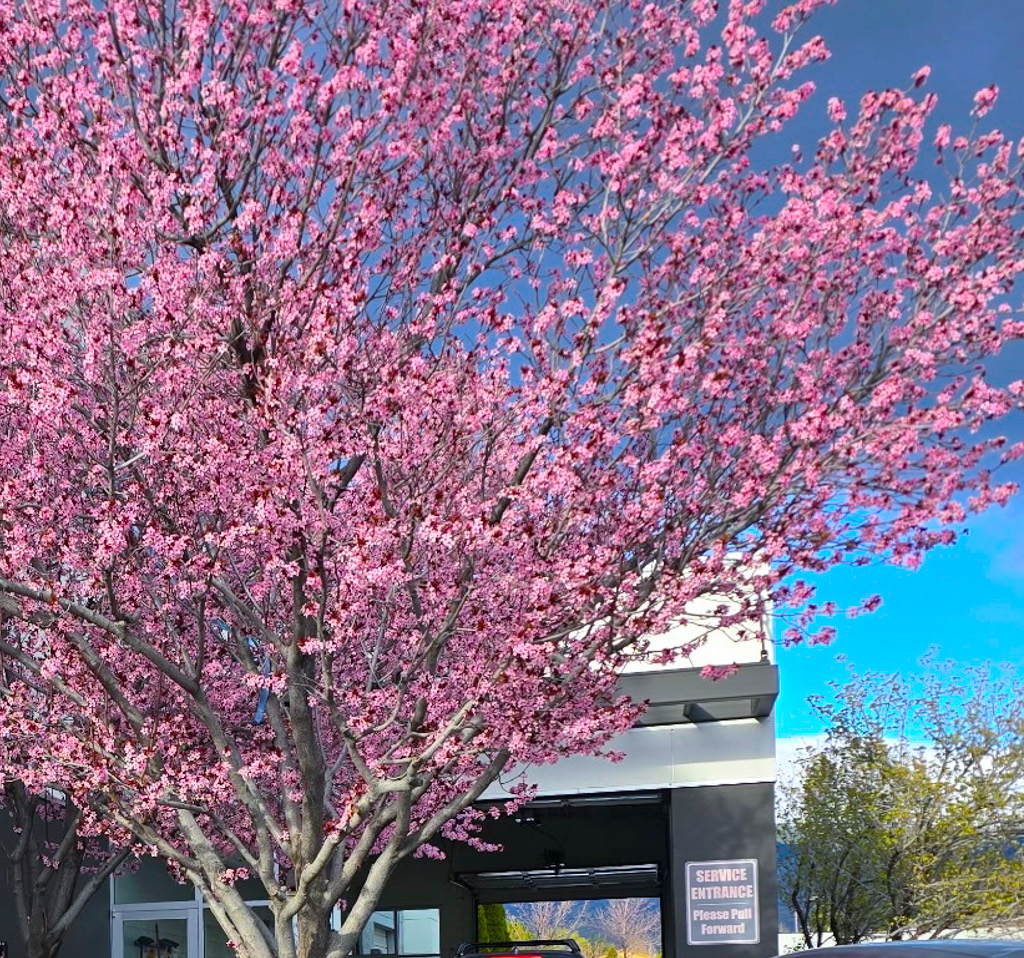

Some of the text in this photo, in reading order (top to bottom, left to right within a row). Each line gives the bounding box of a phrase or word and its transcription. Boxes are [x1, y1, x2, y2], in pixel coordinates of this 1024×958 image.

[696, 868, 748, 882] SERVICE
[691, 885, 753, 900] ENTRANCE
[693, 908, 752, 921] Please Pull
[701, 922, 745, 935] Forward
